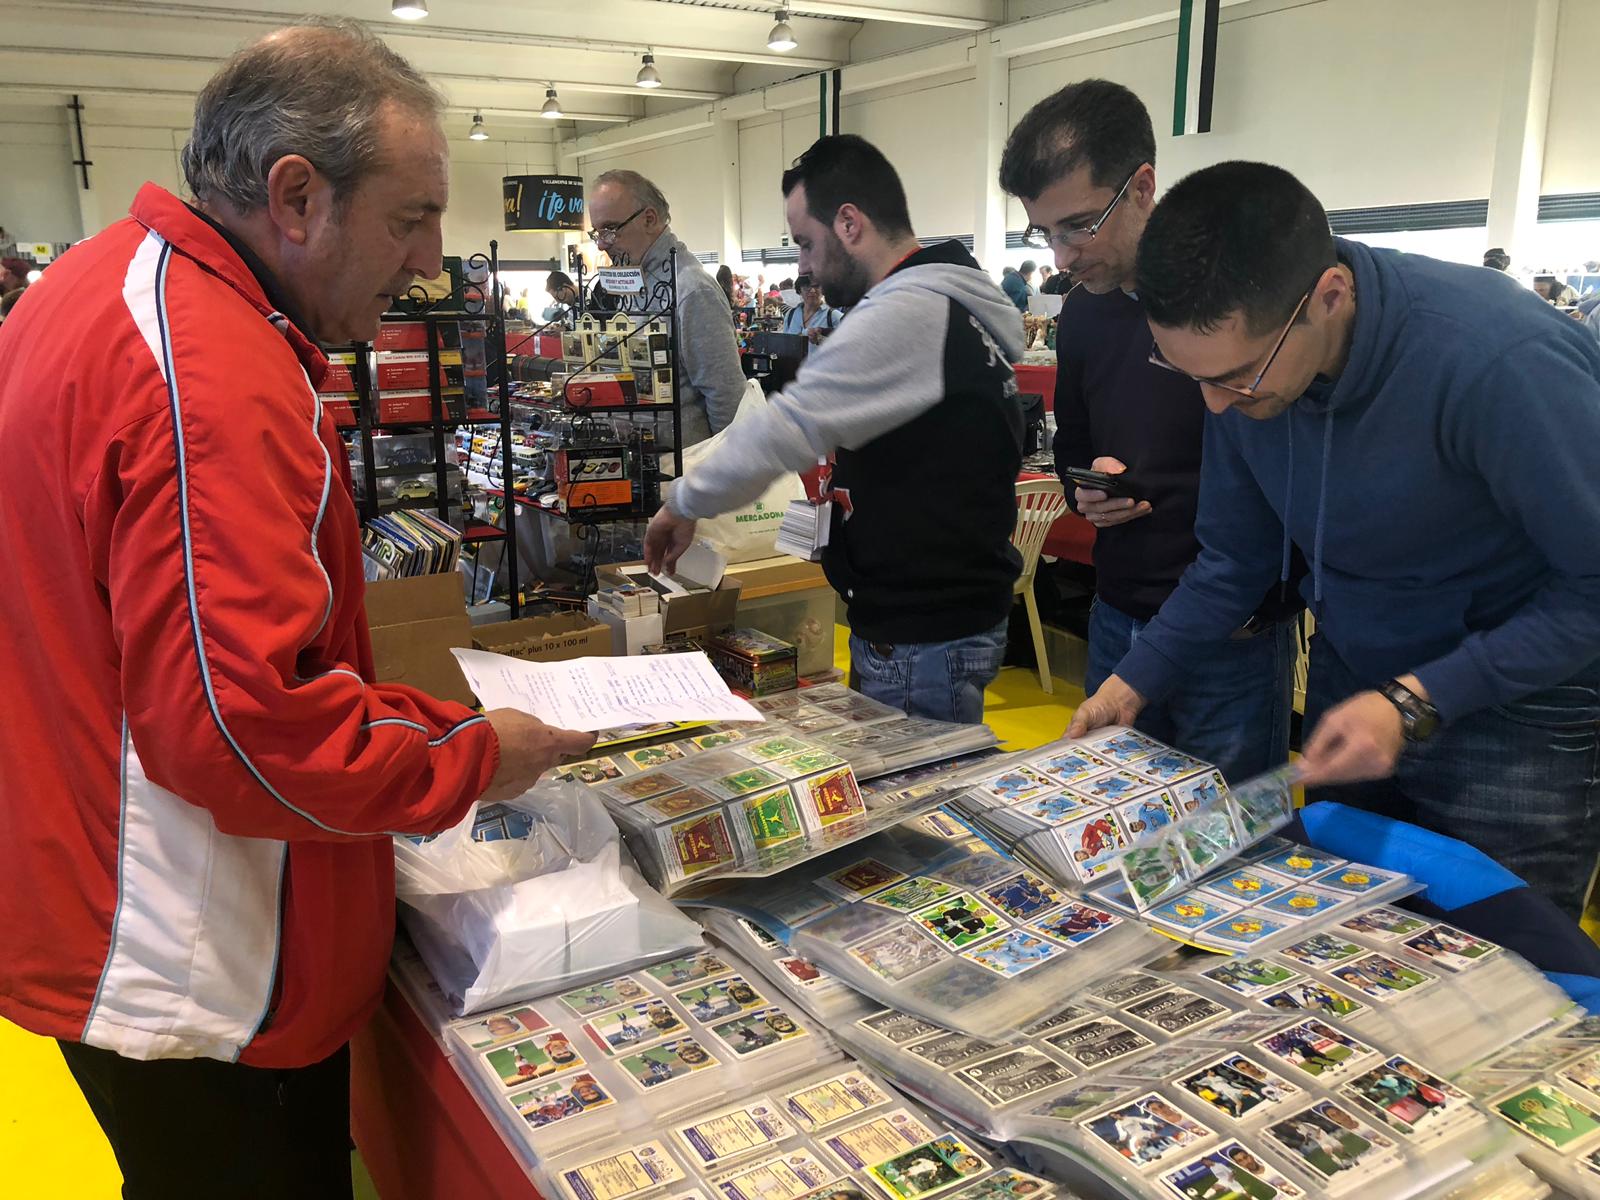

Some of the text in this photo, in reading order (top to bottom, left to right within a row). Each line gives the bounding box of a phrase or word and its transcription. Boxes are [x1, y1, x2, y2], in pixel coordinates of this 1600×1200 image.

[528, 645, 543, 656] plus
[545, 642, 554, 651] 10
[563, 638, 577, 648] 100
[579, 635, 588, 645] ml
[1063, 1029, 1101, 1047] TOYOTA
